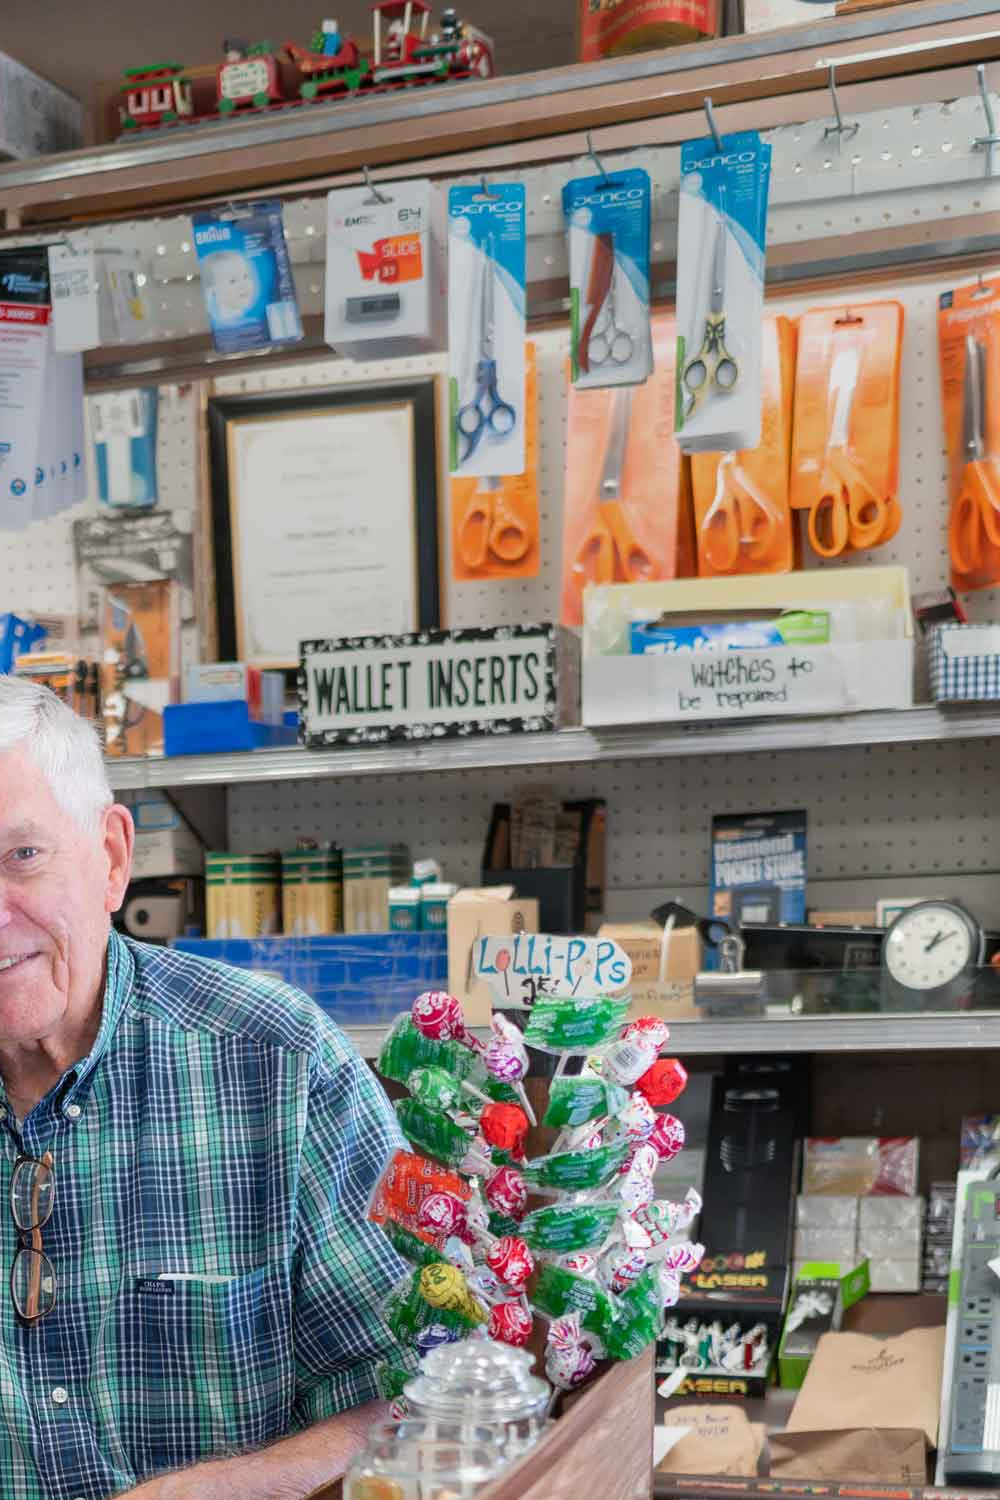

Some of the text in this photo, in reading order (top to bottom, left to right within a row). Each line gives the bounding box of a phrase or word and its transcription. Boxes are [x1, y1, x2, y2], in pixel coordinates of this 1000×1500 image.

[788, 656, 813, 677] to
[313, 651, 539, 716] WALLET INSERTS
[678, 683, 787, 711] be repaired
[696, 1272, 768, 1290] LASER
